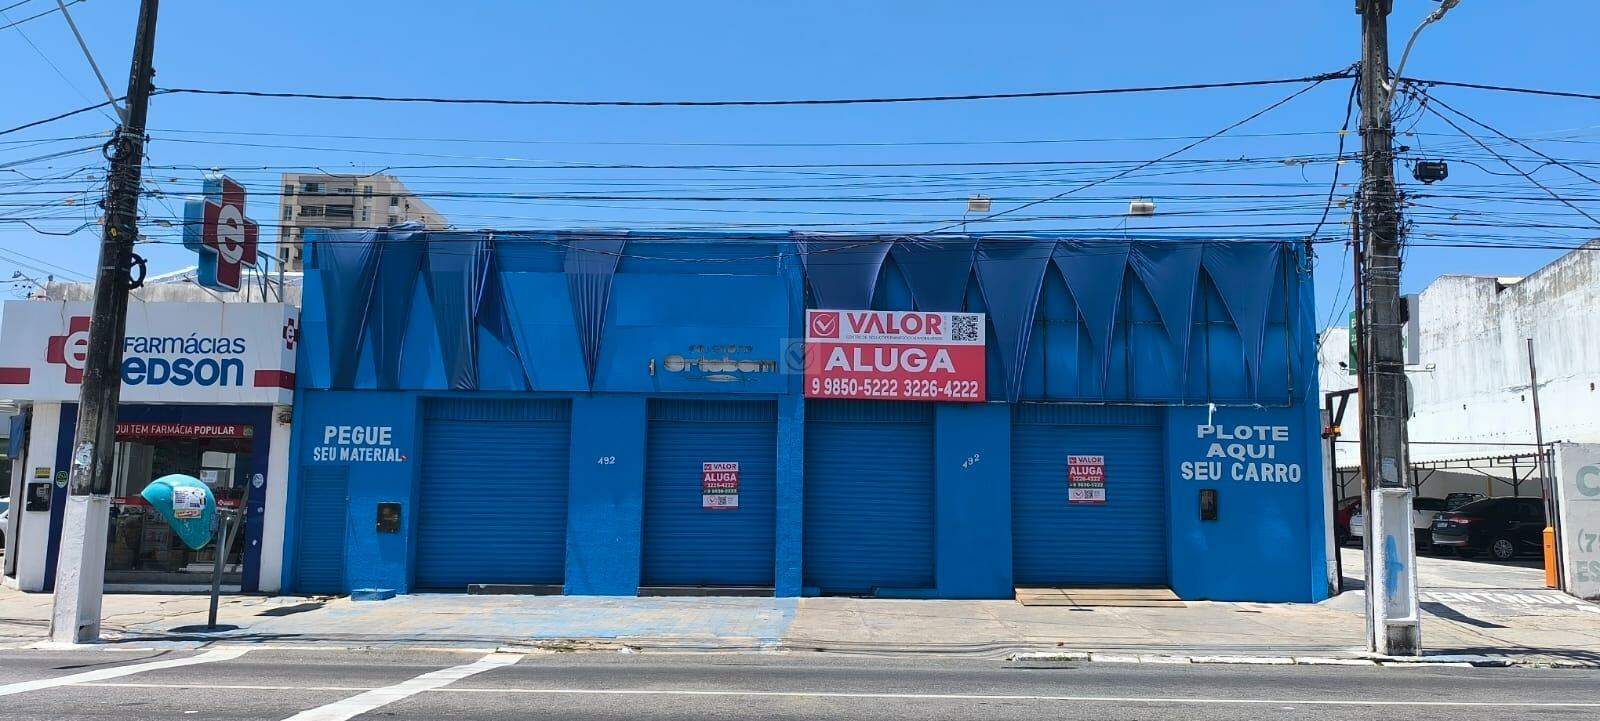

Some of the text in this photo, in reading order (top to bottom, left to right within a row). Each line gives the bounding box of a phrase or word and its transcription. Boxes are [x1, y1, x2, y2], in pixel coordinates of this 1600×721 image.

[846, 312, 942, 335] VALOR
[824, 346, 956, 373] ALUGA
[811, 377, 978, 398] 9 9850-5222 3226-4222
[115, 423, 235, 435] QUI TEM FARMÁCIA POPULAR
[323, 425, 392, 446] PEGUE
[1197, 424, 1289, 442] PLOTE
[313, 446, 403, 462] SEU MATERIAL
[597, 455, 616, 465] 492
[962, 453, 980, 469] 492
[1206, 442, 1275, 462] AQUI
[704, 472, 737, 482] ALUGA
[1069, 466, 1103, 475] ALUGA
[1180, 461, 1301, 483] SEU CARRO
